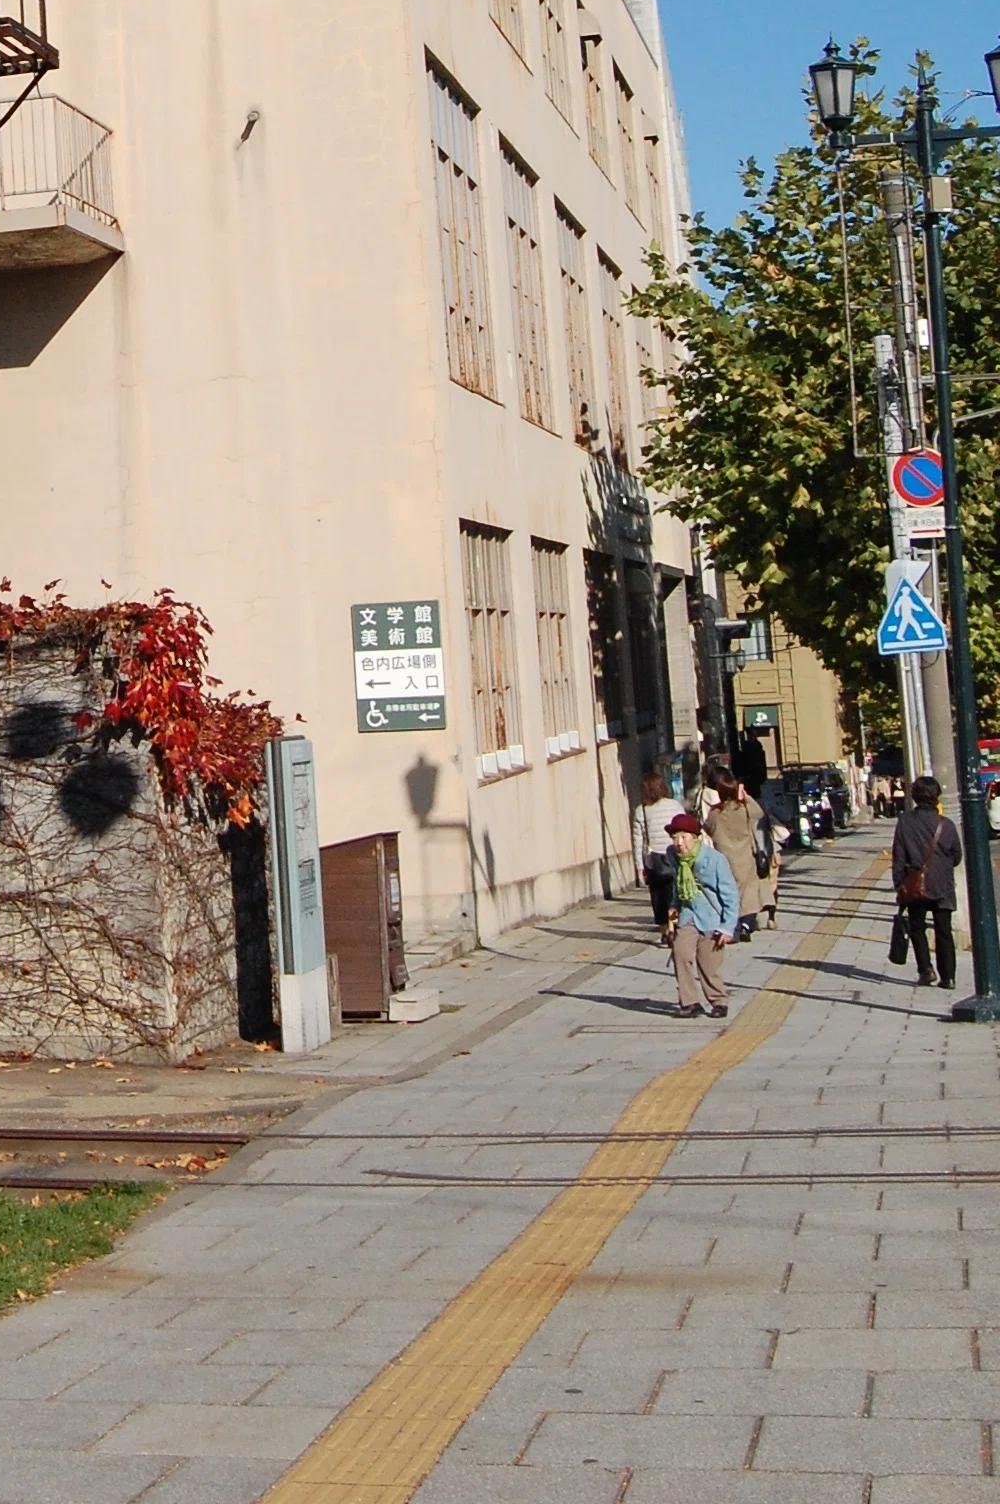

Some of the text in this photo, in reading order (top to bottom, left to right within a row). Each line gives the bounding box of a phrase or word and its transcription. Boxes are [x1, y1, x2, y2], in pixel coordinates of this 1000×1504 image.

[359, 605, 432, 626] 文学館
[360, 626, 433, 647] 美術館
[361, 654, 437, 672] 色内広場側
[404, 675, 439, 690] 入口
